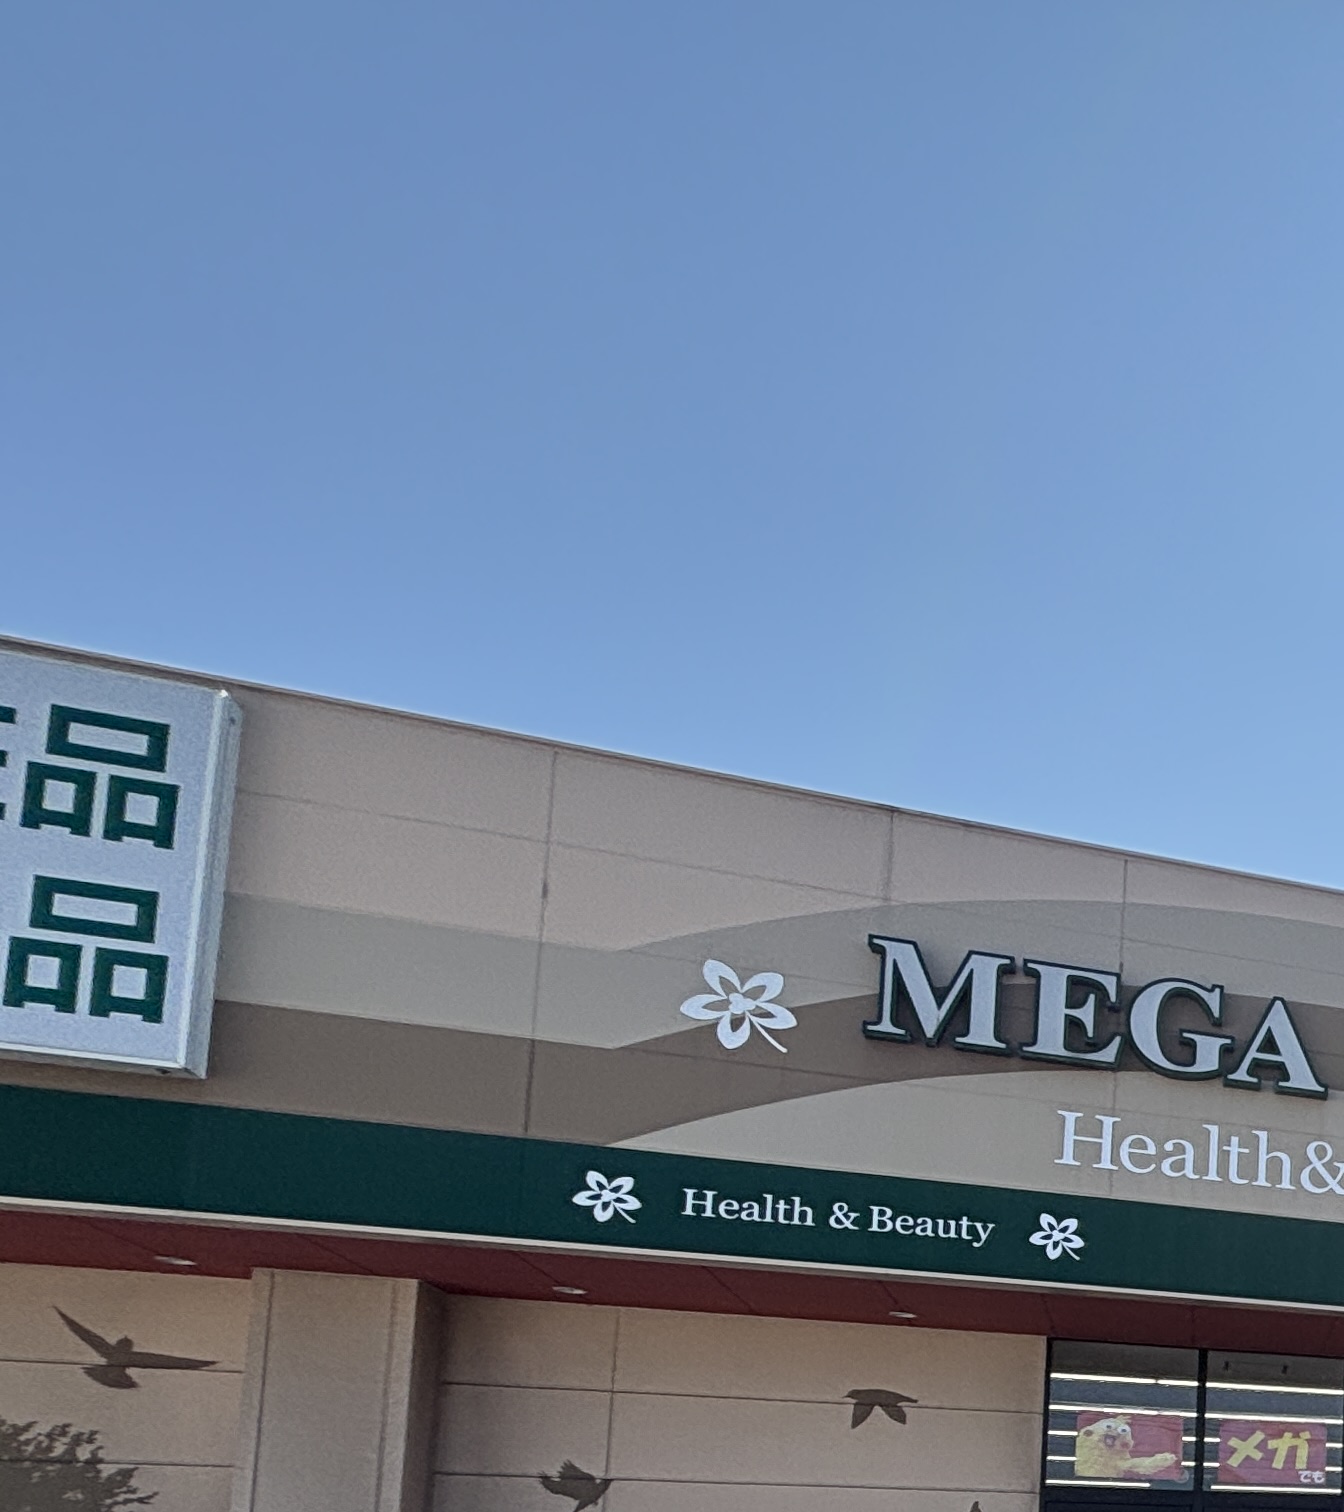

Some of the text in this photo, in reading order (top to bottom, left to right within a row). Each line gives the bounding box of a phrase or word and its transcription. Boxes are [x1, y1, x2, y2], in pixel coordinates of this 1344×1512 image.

[0, 703, 181, 850] 品
[862, 933, 1329, 1099] MEGA
[681, 1188, 995, 1247] Health & Beauty
[1226, 1430, 1311, 1470] メガ
[1298, 1470, 1326, 1484] でも
